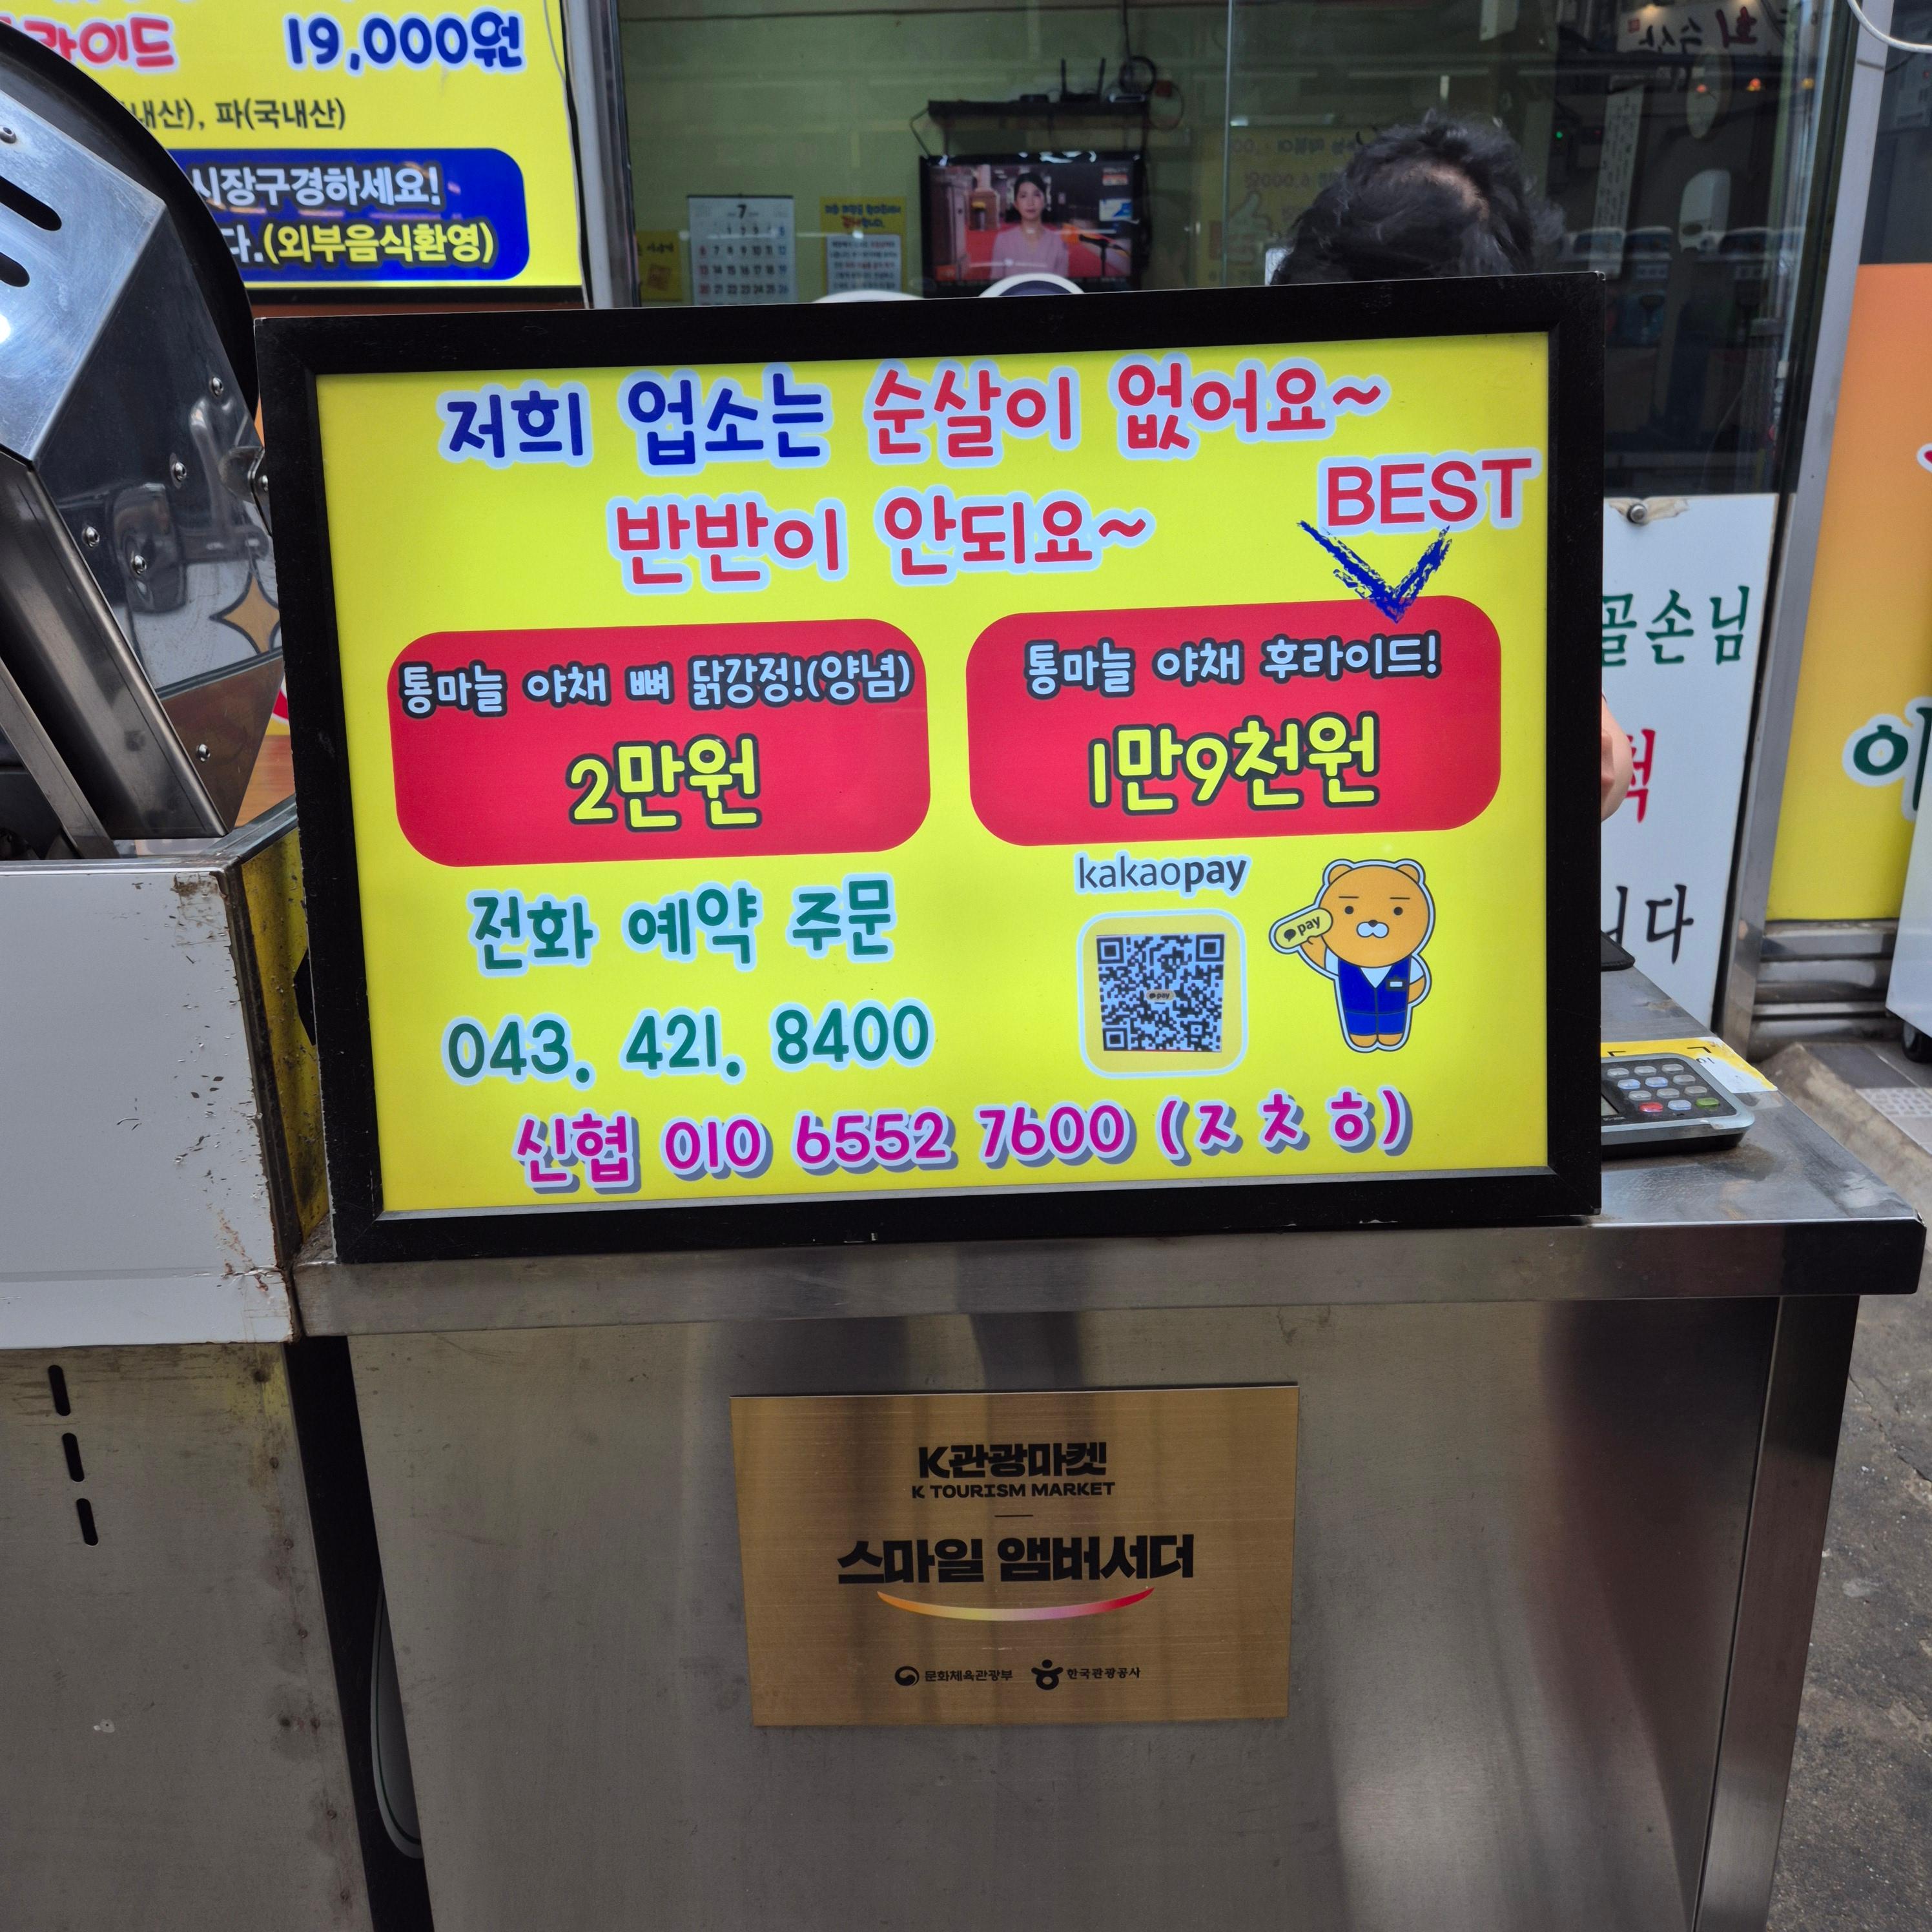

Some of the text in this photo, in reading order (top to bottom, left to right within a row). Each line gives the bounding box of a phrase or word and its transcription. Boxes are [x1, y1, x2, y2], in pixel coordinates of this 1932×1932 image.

[0, 11, 522, 70] 라이드 19,000원
[119, 98, 345, 130] 내산), 파(국내산)
[192, 166, 441, 205] 시장구경하세요!
[447, 362, 1381, 465] 저희 업소는 순살이 없어요~
[1326, 458, 1532, 526] BEST
[617, 495, 1147, 584] 반반이 안되요~
[403, 653, 911, 714] 통마늘 야채 뼈 닭강정!(양념)
[1029, 635, 1437, 695] 통마늘 야채 후라이드!
[571, 739, 757, 828] 2만원
[1094, 716, 1375, 811] 1만9천원
[1079, 857, 1247, 893] kakaopay
[473, 879, 891, 970] 전화 예약 주문
[1297, 914, 1322, 937] pay
[448, 1005, 929, 1084] 043. 421. 8400
[517, 1113, 628, 1182] 신협
[666, 1118, 761, 1169] 010
[797, 1112, 946, 1162] 6552
[980, 1104, 1124, 1158] 7600
[912, 1481, 1116, 1499] K TOURISM MARKET
[919, 1442, 1107, 1479] K관광마켓
[837, 1534, 1195, 1584] 스마일 앰버서더
[925, 1667, 1141, 1682] 문화체육관광부 한국관광공사
